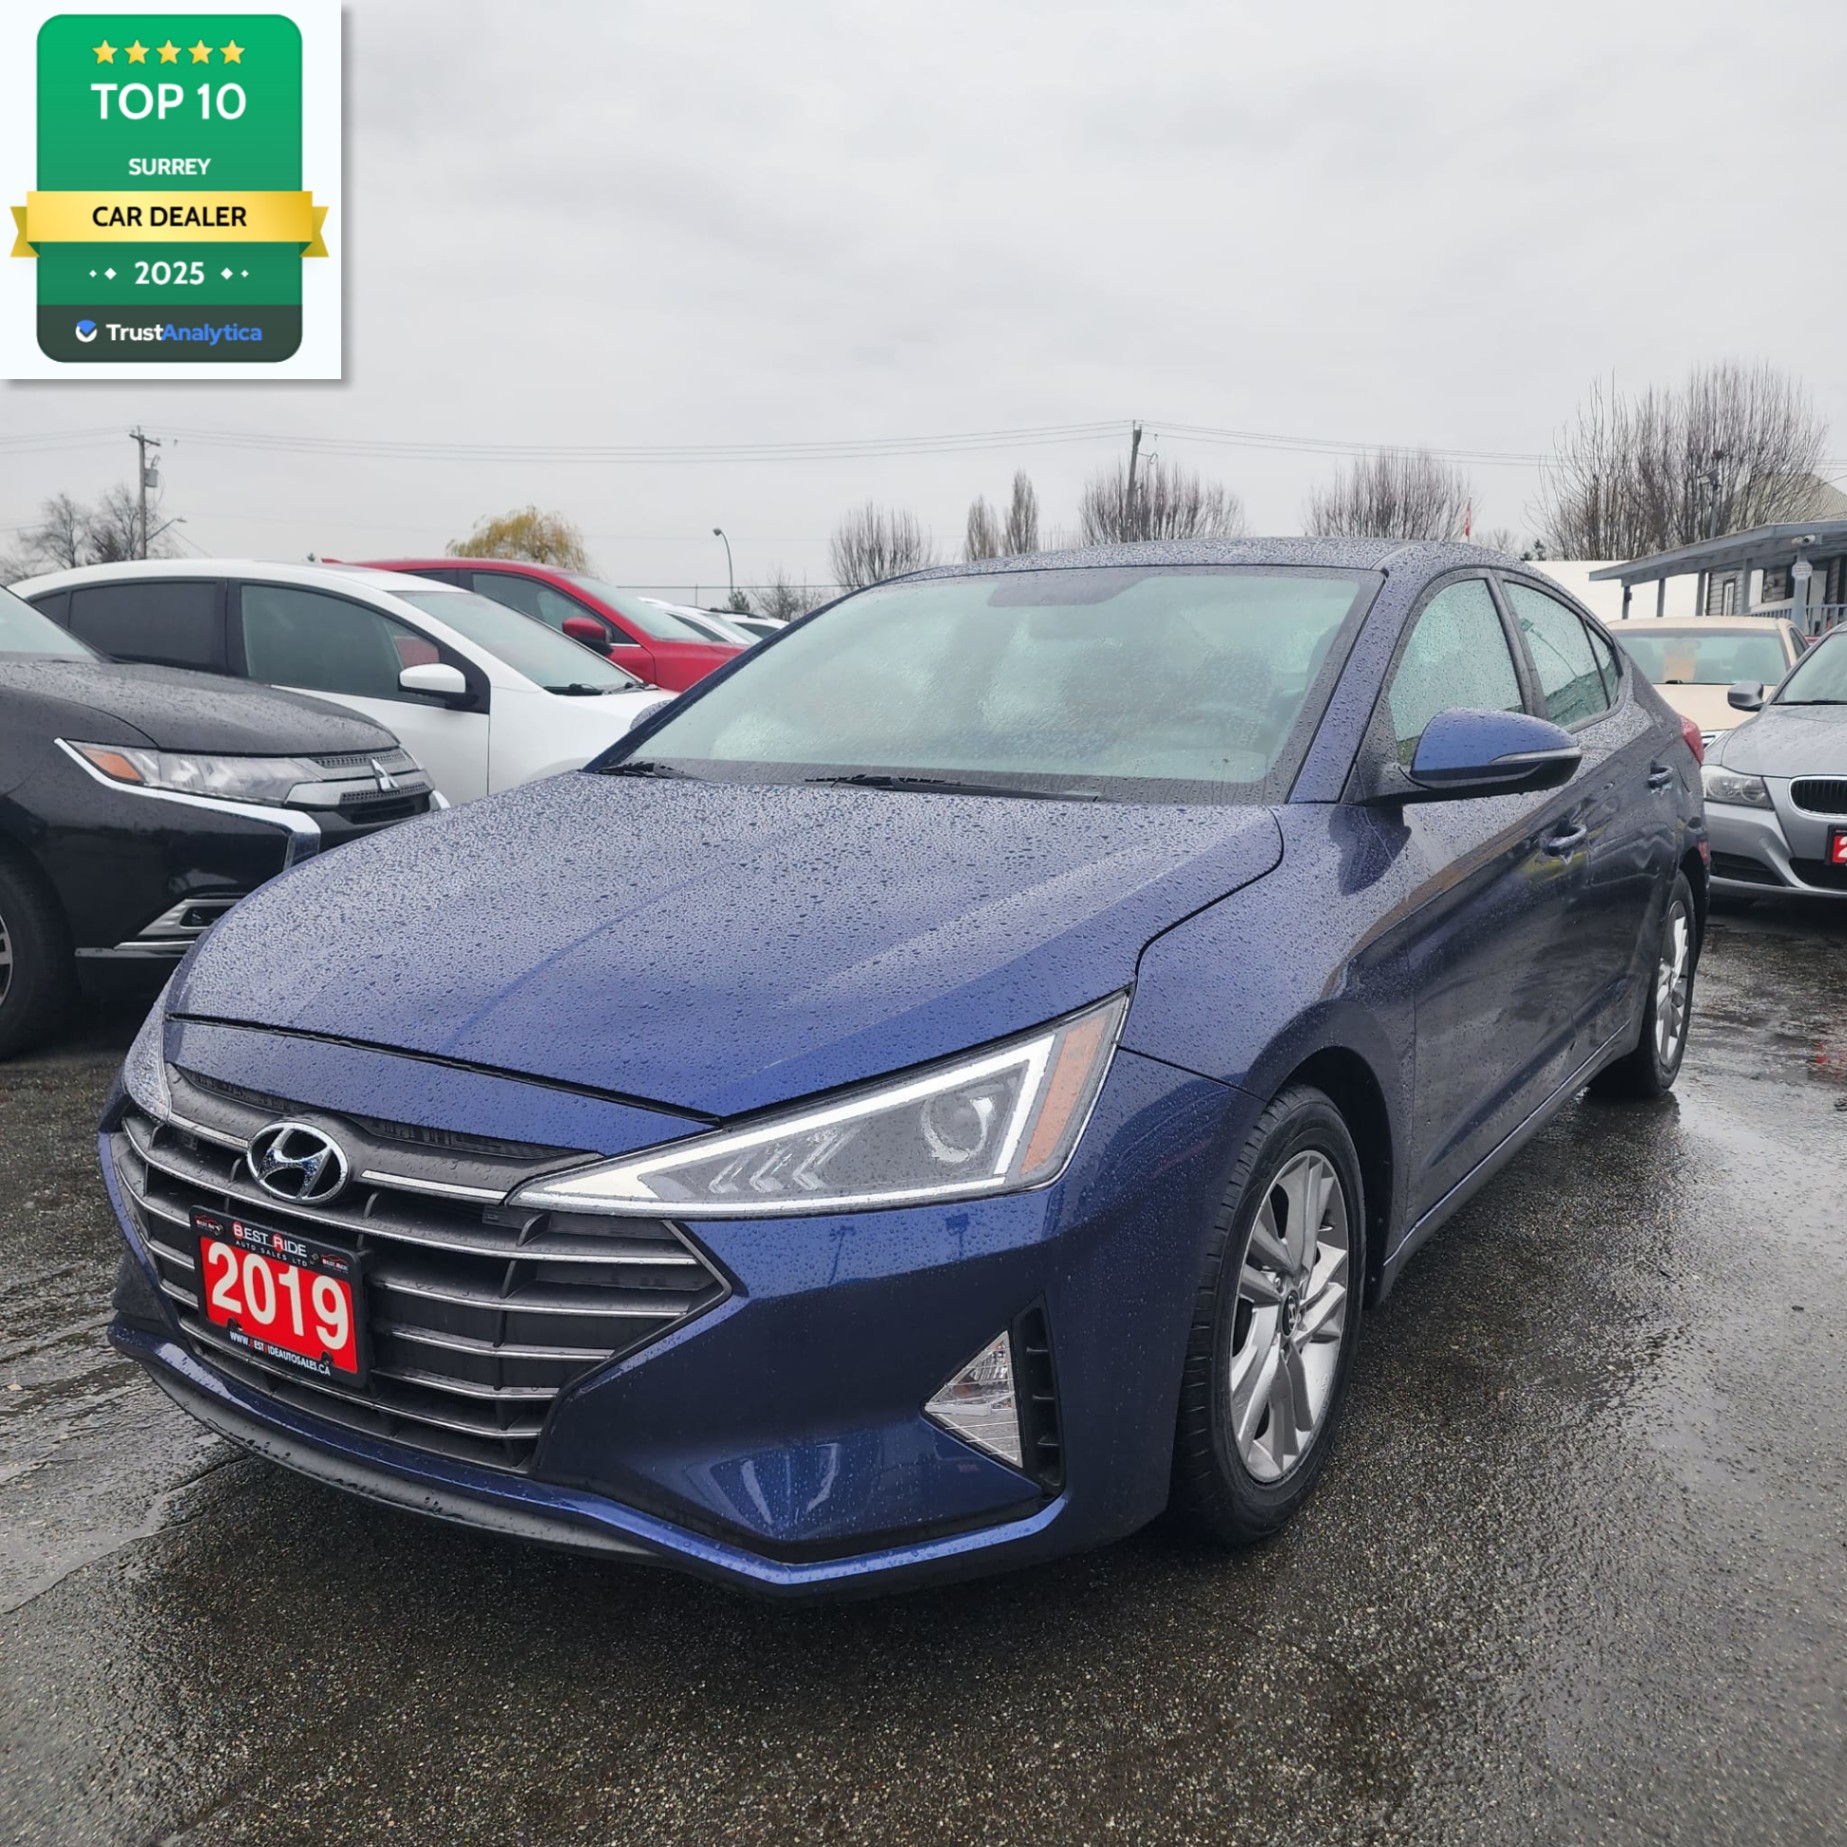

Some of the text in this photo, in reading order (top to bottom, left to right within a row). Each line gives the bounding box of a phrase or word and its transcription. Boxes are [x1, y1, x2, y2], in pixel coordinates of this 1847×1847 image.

[233, 1222, 269, 1245] BEST
[273, 1233, 307, 1257] RIDE
[236, 1240, 256, 1251] AUTO
[260, 1247, 287, 1261] SALES
[208, 1241, 349, 1350] 2019
